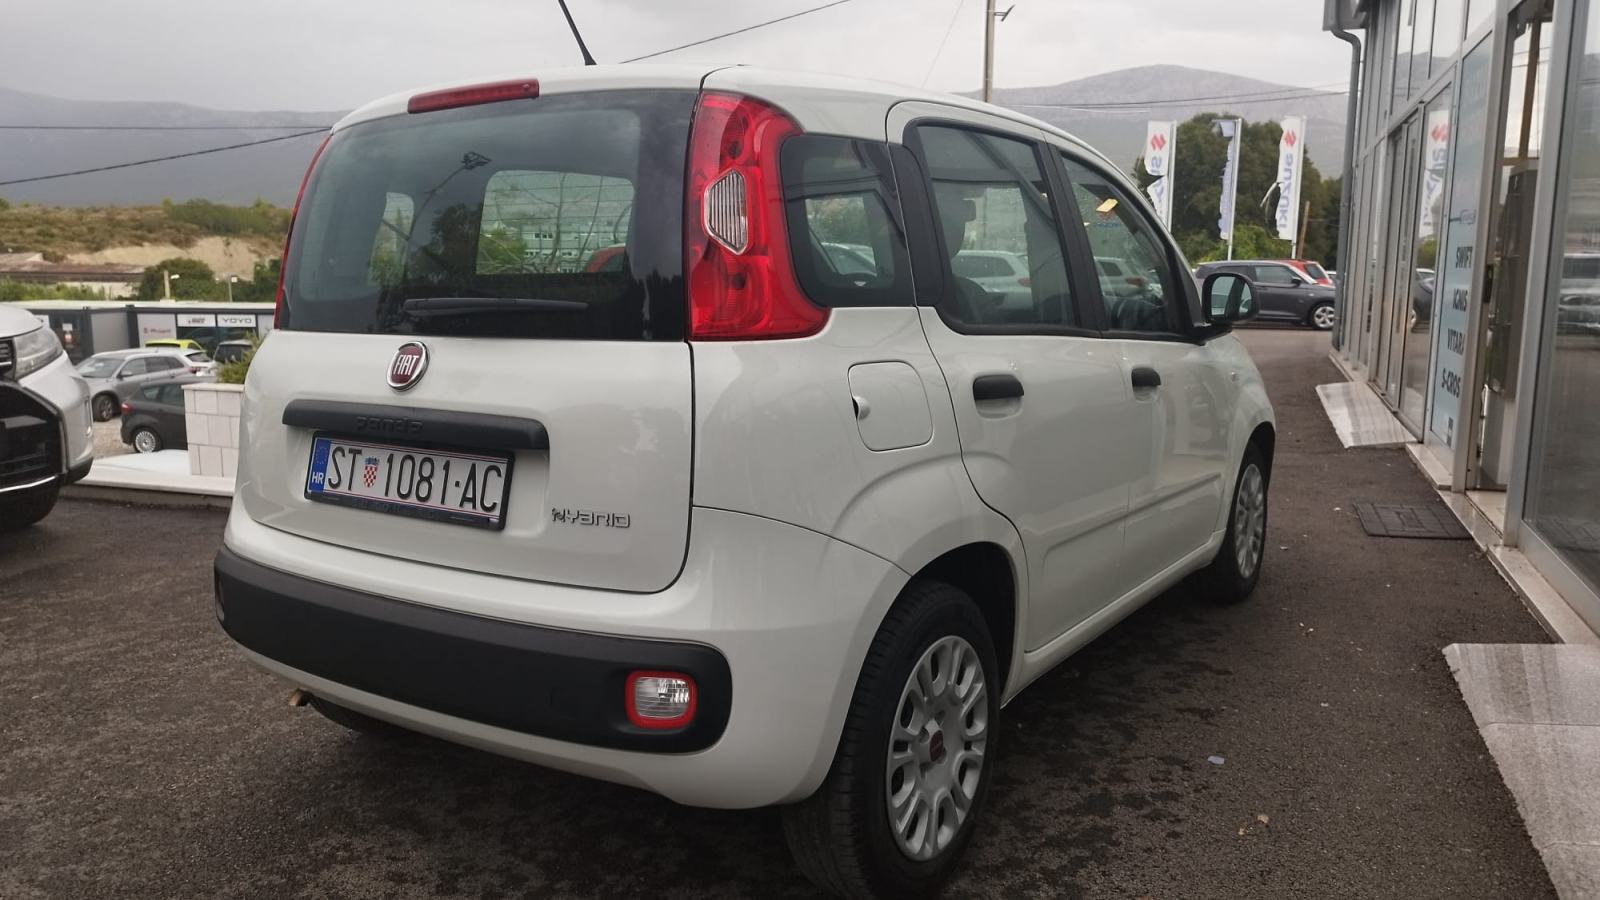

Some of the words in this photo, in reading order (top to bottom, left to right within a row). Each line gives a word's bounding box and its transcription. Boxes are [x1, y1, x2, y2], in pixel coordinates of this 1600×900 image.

[393, 354, 420, 376] FIAT
[311, 471, 324, 484] HR
[327, 446, 363, 491] ST
